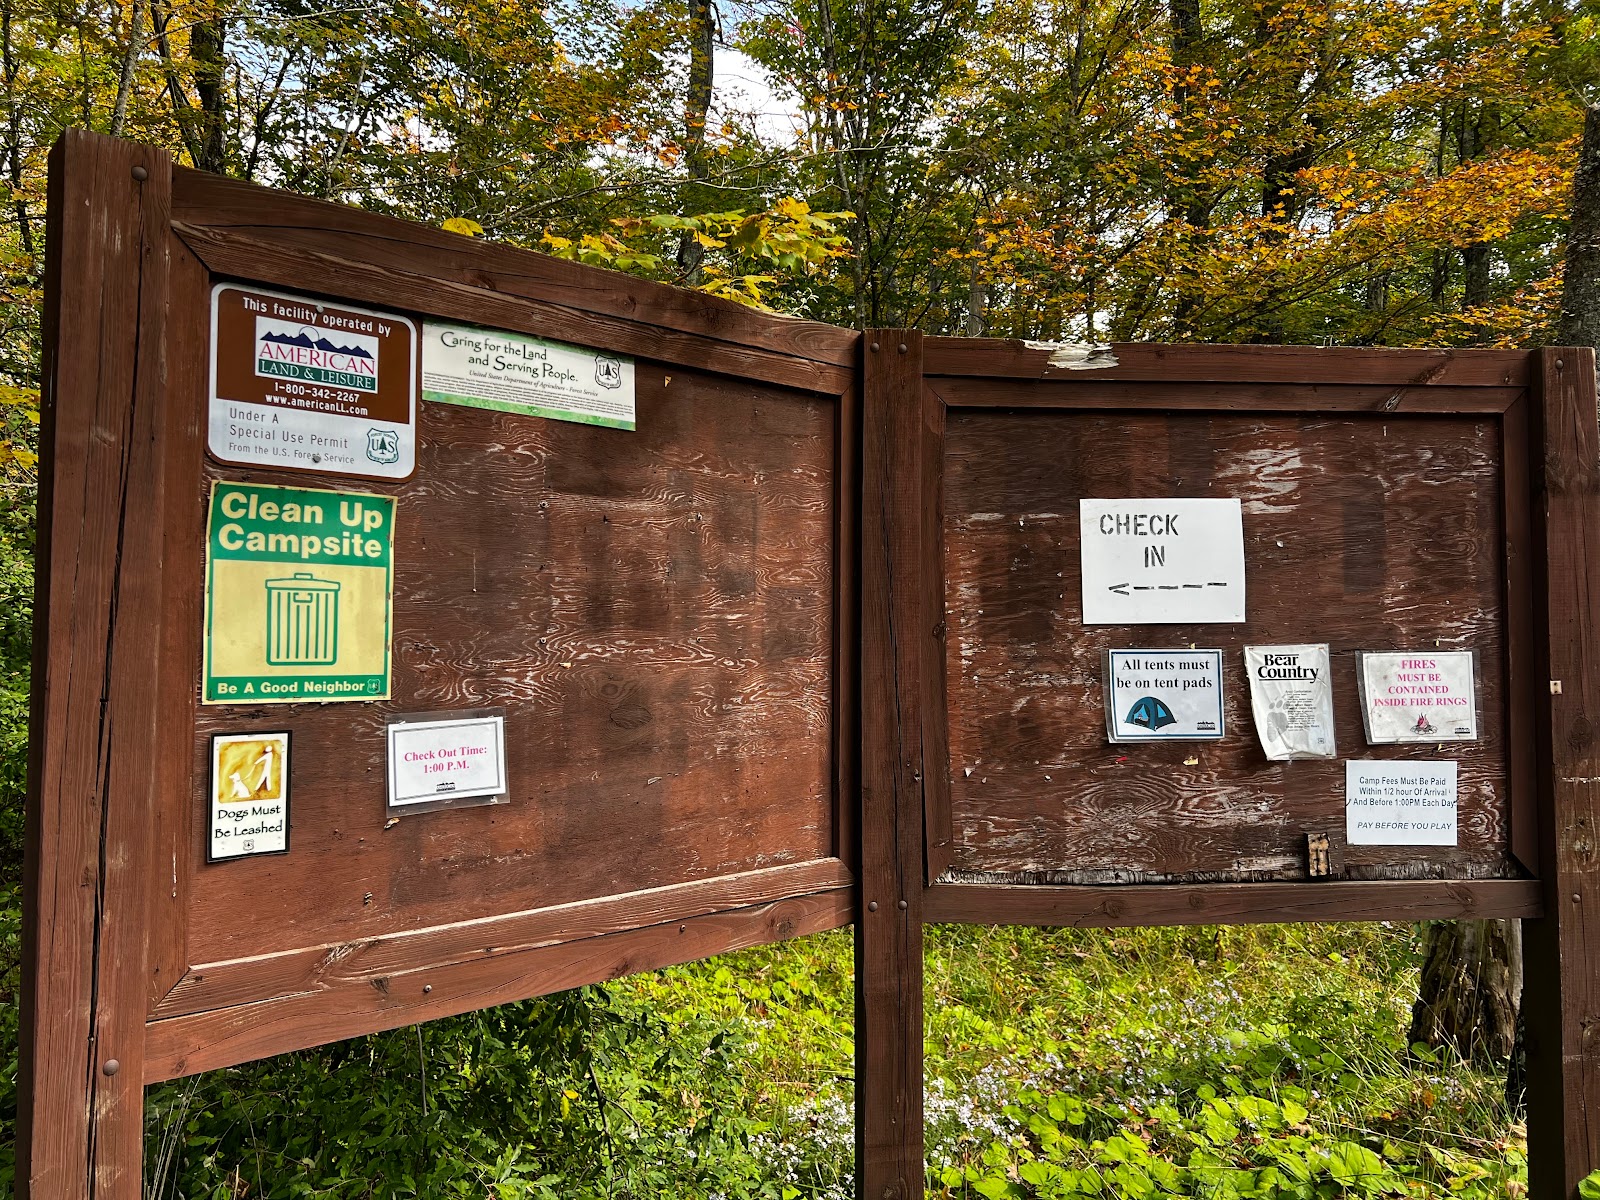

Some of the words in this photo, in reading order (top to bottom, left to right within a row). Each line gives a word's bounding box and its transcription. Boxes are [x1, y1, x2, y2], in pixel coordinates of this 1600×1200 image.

[243, 297, 267, 313] This
[274, 302, 318, 324] facility
[323, 314, 373, 332] operated
[378, 323, 391, 337] by
[440, 331, 482, 352] Caring
[484, 338, 501, 352] for
[504, 341, 521, 356] the
[522, 344, 547, 361] Land
[259, 342, 375, 375] AMERICAN
[261, 360, 299, 377] LAND
[303, 367, 315, 380] &
[321, 369, 372, 389] LEISURE
[468, 354, 489, 366] and
[493, 356, 539, 378] Serving
[542, 363, 578, 383] People.
[469, 370, 487, 378] United
[503, 375, 532, 386] Department
[533, 380, 539, 388] of
[539, 381, 565, 391] Agriculture
[569, 386, 582, 394] Forest
[583, 389, 598, 397] Service
[274, 382, 360, 403] 1-800-342-2267
[265, 394, 368, 416] www.americanLL.com
[229, 407, 266, 422] Under
[272, 413, 279, 424] A
[229, 424, 275, 441] Special
[282, 431, 304, 444] Use
[310, 434, 348, 449] Permit
[229, 442, 251, 453] From
[255, 445, 269, 455] the
[272, 447, 290, 457] U.S.
[324, 452, 355, 464] Service
[221, 491, 323, 524] Clean
[339, 501, 383, 533] Up
[1100, 513, 1179, 536] CHECK
[218, 523, 382, 559] Campsite
[1144, 545, 1165, 568] IN
[1122, 659, 1141, 670] All
[1145, 660, 1175, 670] tents
[1179, 660, 1210, 670] must
[1264, 654, 1299, 666] Bear
[1401, 660, 1436, 669] FIRES
[1257, 666, 1319, 683] Country
[1397, 673, 1426, 682] MUST
[1428, 673, 1441, 682] BE
[217, 682, 237, 694] Be
[243, 682, 255, 694] A
[260, 681, 298, 693] Good
[304, 681, 365, 695] Neighbor
[1116, 677, 1131, 688] be
[1135, 680, 1150, 688] on
[1154, 678, 1179, 688] tent
[1183, 676, 1212, 691] pads
[1388, 685, 1449, 694] CONTAINED
[1374, 698, 1407, 707] INSIDE
[1410, 698, 1434, 706] FIRE
[1436, 697, 1467, 706] RINGS
[404, 750, 435, 762] Check
[438, 748, 457, 759] Out
[459, 746, 487, 756] Time:
[423, 762, 444, 774] 1:00
[447, 760, 470, 771] P.M.
[1359, 776, 1380, 785] Camp
[1381, 776, 1399, 785] Fees
[1400, 777, 1418, 785] Must
[1430, 778, 1446, 786] Paid
[1359, 787, 1382, 795] Within
[1396, 788, 1412, 796] hour
[1414, 788, 1423, 796] Of
[1423, 788, 1447, 796] Arrival
[1352, 798, 1368, 806] And
[1369, 798, 1393, 806] Before
[1394, 799, 1420, 807] 1:00PM
[1422, 799, 1440, 807] Each
[217, 809, 249, 821] Dogs
[252, 805, 281, 816] Must
[214, 829, 231, 838] Be
[234, 819, 283, 836] Leashed
[1375, 822, 1409, 830] BEFORE
